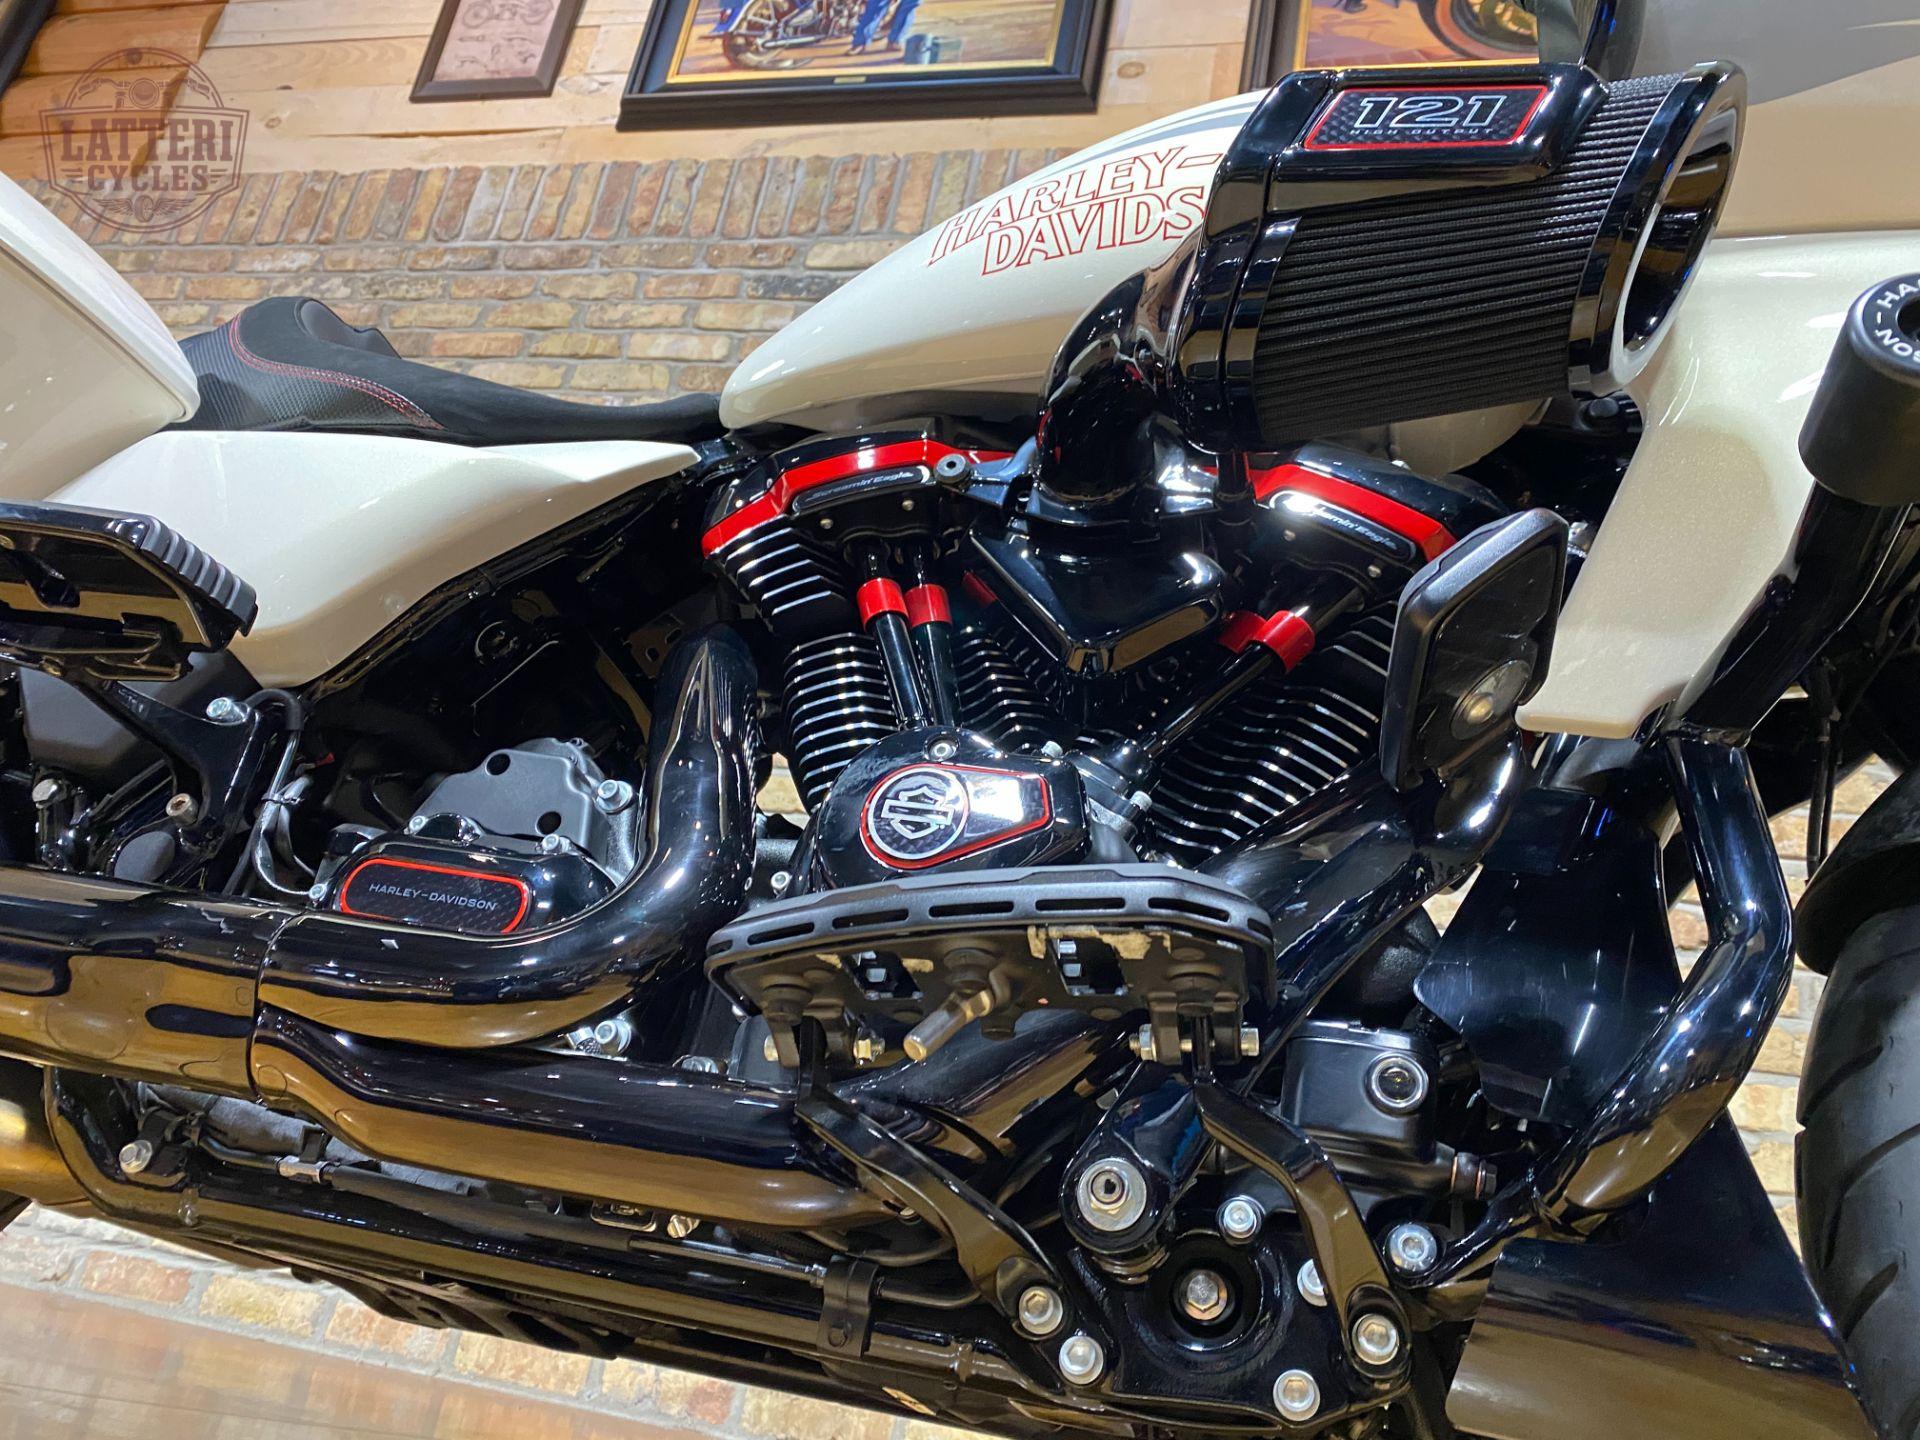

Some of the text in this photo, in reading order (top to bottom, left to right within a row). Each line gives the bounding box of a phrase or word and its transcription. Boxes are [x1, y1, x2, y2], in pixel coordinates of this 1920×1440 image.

[1354, 95, 1507, 128] 121
[1410, 127, 1494, 135] OUTPUT
[872, 471, 915, 483] Eagle
[368, 883, 498, 911] HARLEY-DAVIDSON
